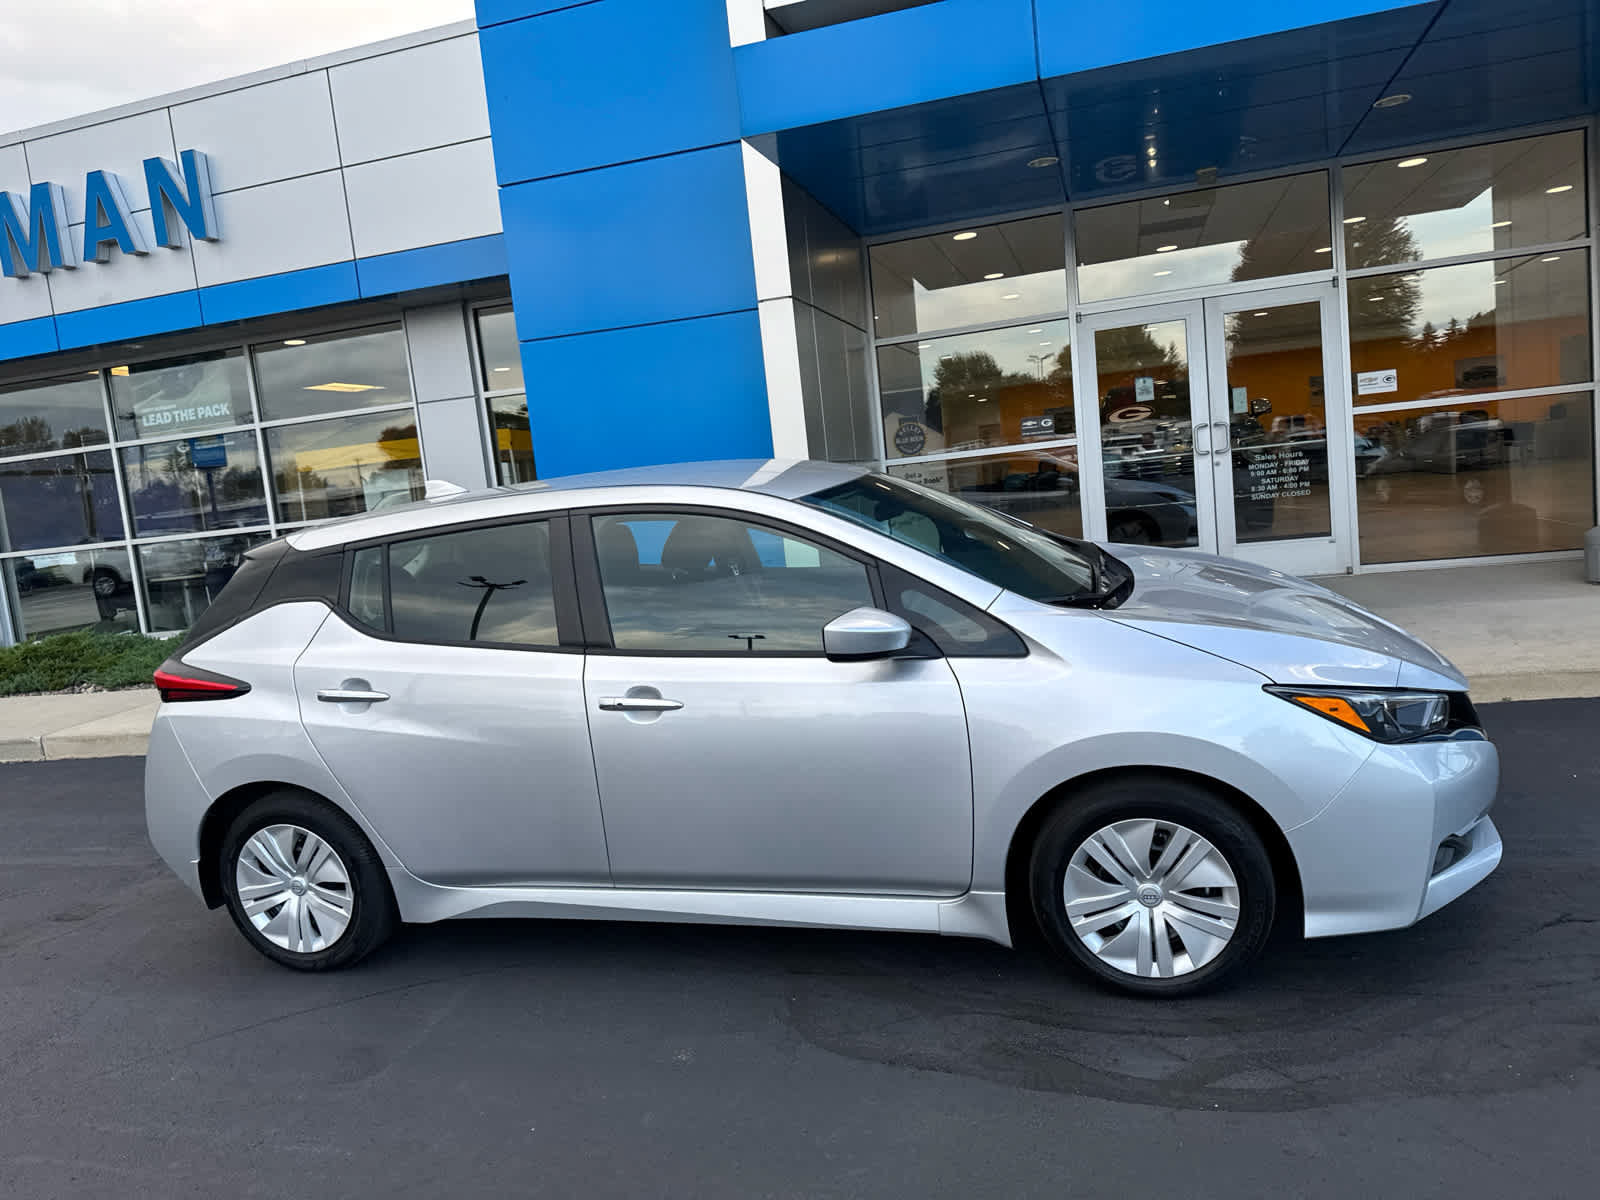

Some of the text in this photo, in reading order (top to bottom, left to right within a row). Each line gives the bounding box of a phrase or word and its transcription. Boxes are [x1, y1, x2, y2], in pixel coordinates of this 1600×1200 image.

[0, 149, 214, 278] MAN
[142, 412, 172, 426] LEAD
[172, 408, 196, 422] THE
[197, 403, 230, 418] PACK
[1255, 451, 1303, 461] Sales Hours
[1248, 461, 1279, 470] MONDAY
[1284, 459, 1310, 467] FRIDAY
[1261, 475, 1299, 484] SATURDAY
[1251, 489, 1311, 501] SUNDAY CLOSED
